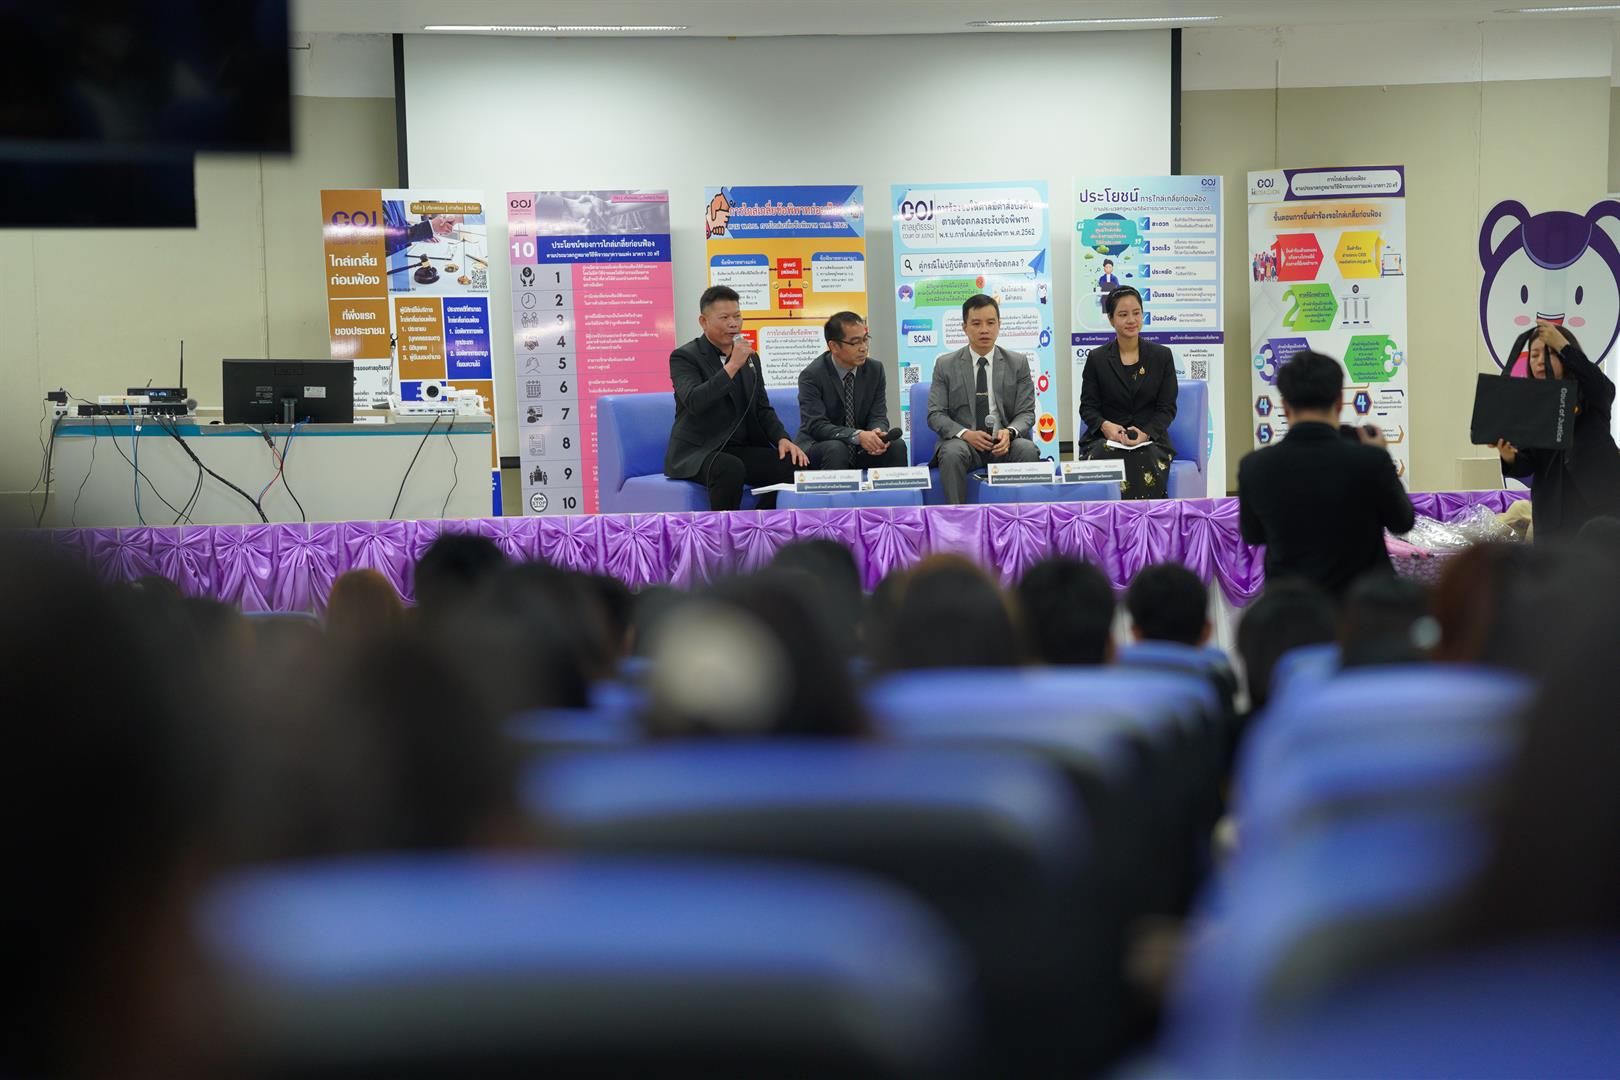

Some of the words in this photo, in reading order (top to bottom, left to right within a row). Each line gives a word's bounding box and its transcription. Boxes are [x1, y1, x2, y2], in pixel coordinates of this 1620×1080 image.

[1257, 179, 1274, 188] COJ
[1080, 188, 1139, 203] ประโยชน์
[511, 200, 531, 208] COJ
[902, 200, 933, 221] COJ
[1273, 210, 1381, 222] ขั้นตอนการยื่นคำร้องขอไกล่เกลี่ยก่อนฟ้อง
[332, 211, 376, 228] COJ
[942, 215, 1029, 225] ตามข้อตกลงระงับข้อพิพาท
[902, 223, 934, 233] ศาลยุติธรรม
[512, 242, 534, 258] 10
[552, 239, 655, 249] ประโยชน์ของการไกล่เกลี่ยก่อนฟ้อง
[329, 252, 377, 267] ไกล่เกลี่ย
[918, 258, 1019, 272] คู่กรณีไม่ปฏิบัติตามบันทึกข้อตกลง
[331, 273, 380, 285] ก่อนฟ้อง
[555, 272, 560, 283] 1
[555, 294, 563, 306] 2
[342, 309, 376, 320] ที่พึ่งแรก
[556, 315, 564, 326] 3
[335, 327, 385, 335] ของประชาชน
[557, 336, 565, 347] 4
[558, 357, 566, 369] 5
[560, 381, 568, 393] 6
[1259, 398, 1268, 414] 4
[1357, 395, 1366, 411] 4
[562, 408, 570, 420] 7
[1559, 408, 1565, 416] of
[1260, 425, 1269, 442] 5
[1556, 417, 1564, 442] Justice
[563, 437, 570, 449] 8
[564, 468, 572, 480] 9
[562, 497, 576, 509] 10
